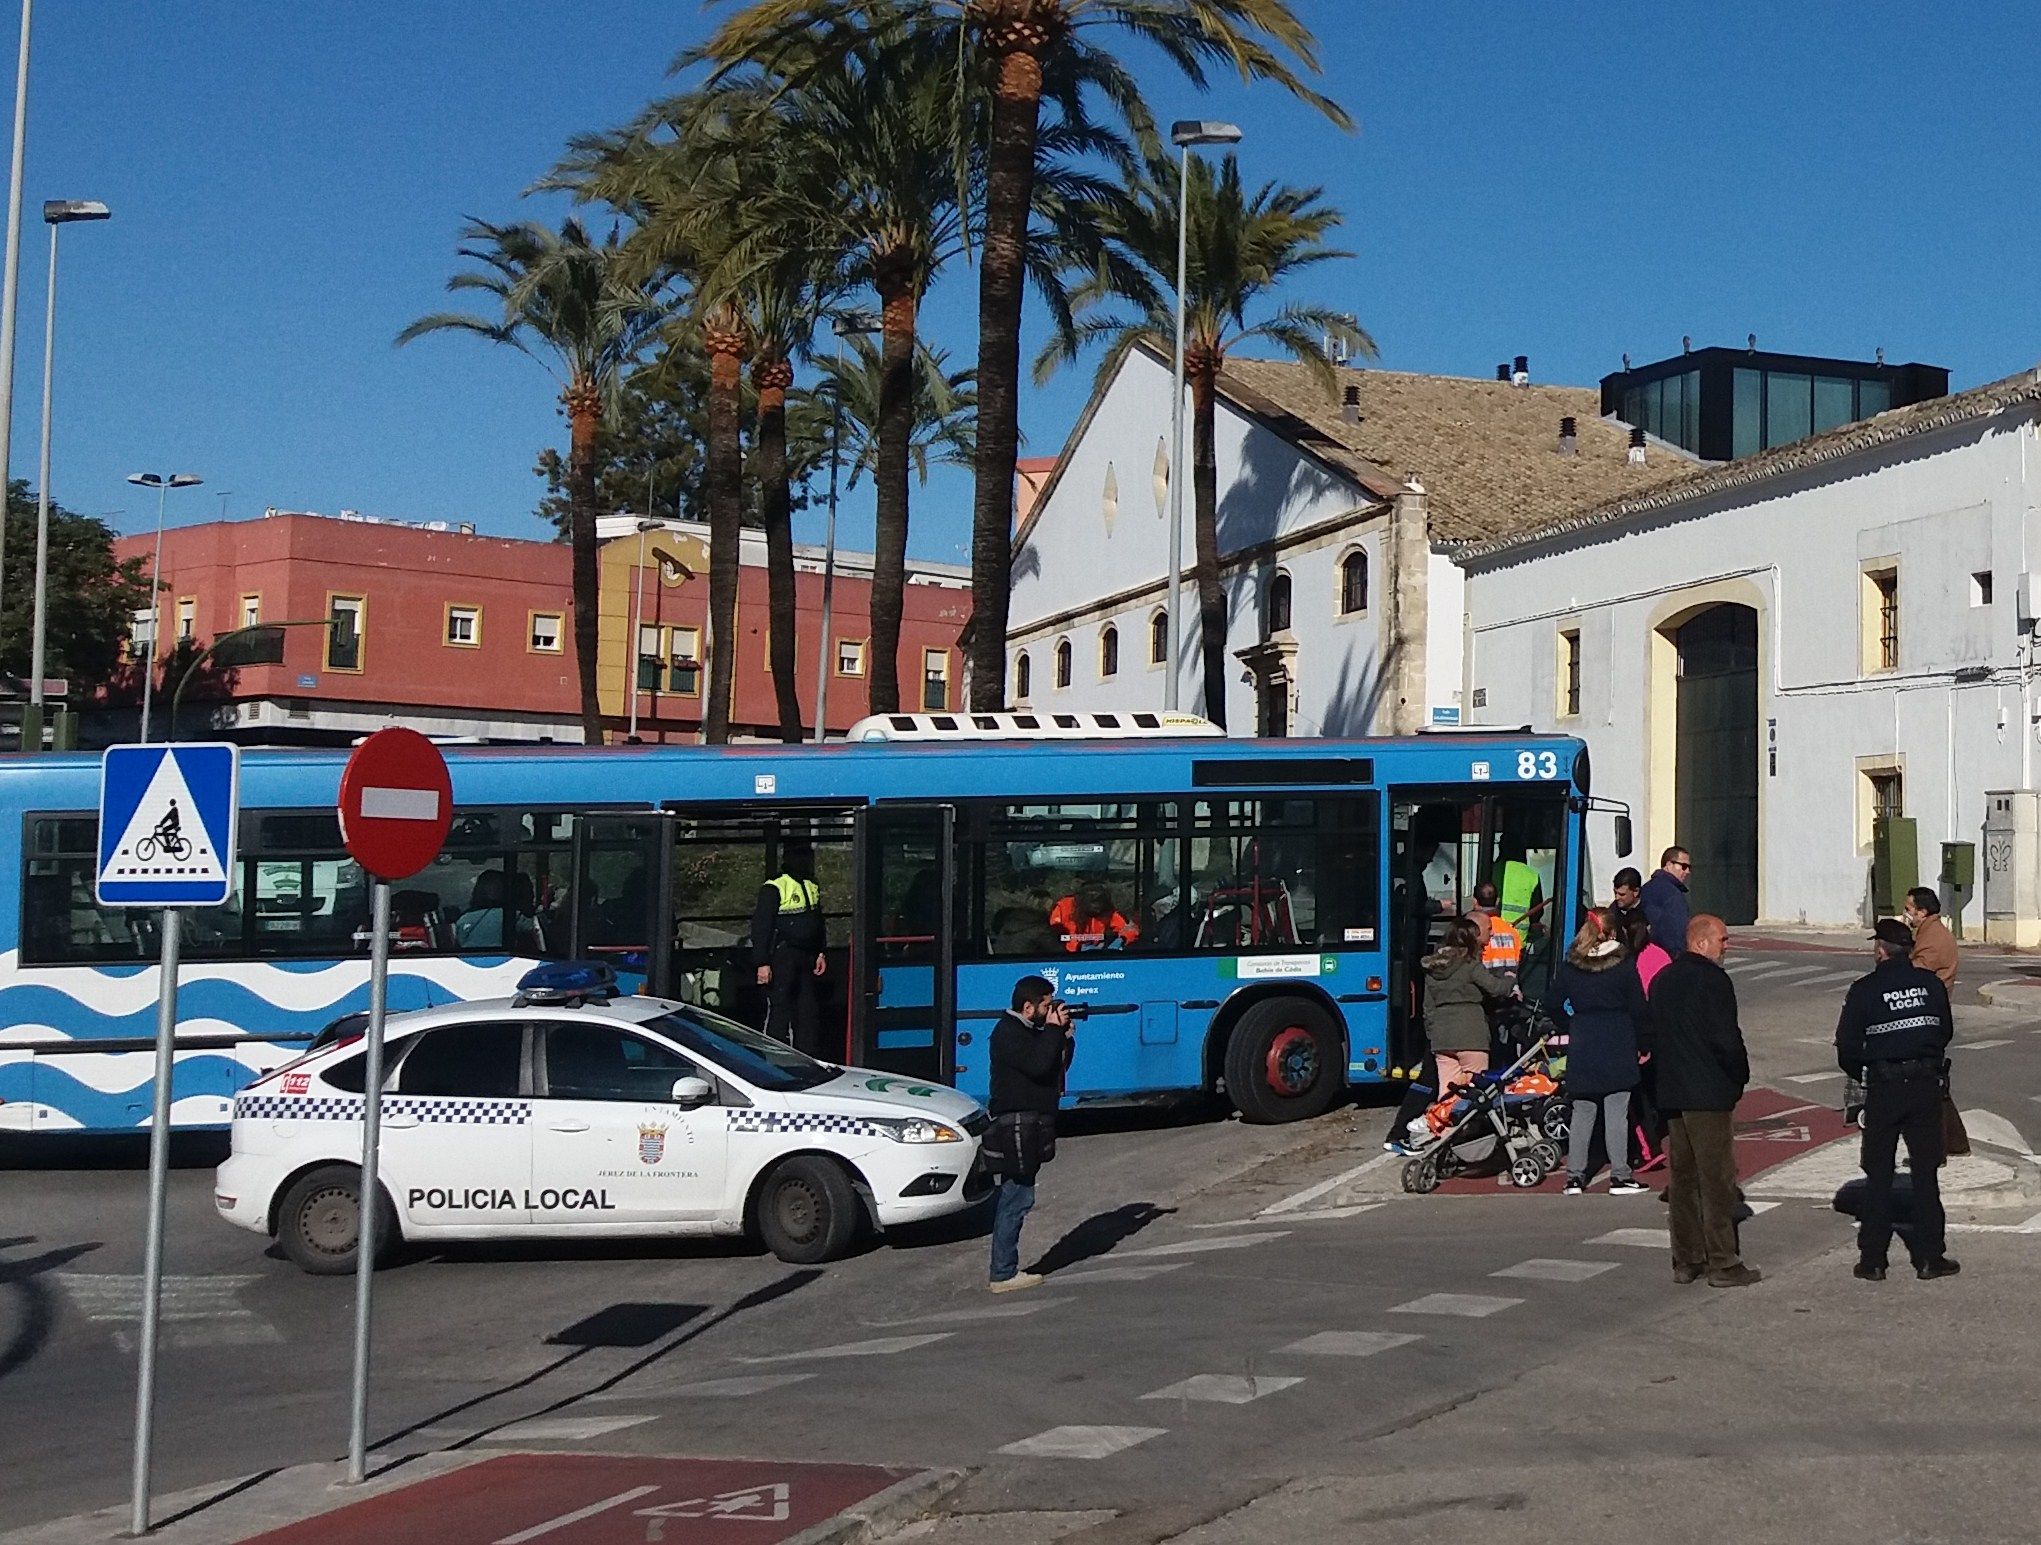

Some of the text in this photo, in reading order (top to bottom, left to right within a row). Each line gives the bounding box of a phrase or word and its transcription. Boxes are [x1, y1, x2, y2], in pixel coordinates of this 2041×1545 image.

[1517, 751, 1558, 779] 83
[1065, 972, 1125, 982] Ayuntamiento
[1064, 987, 1099, 996] de Jerez
[1883, 987, 1929, 1003] POLICIA
[1889, 997, 1926, 1011] LOCAL
[289, 1076, 310, 1087] 112
[408, 1188, 616, 1209] POLICIA LOCAL
